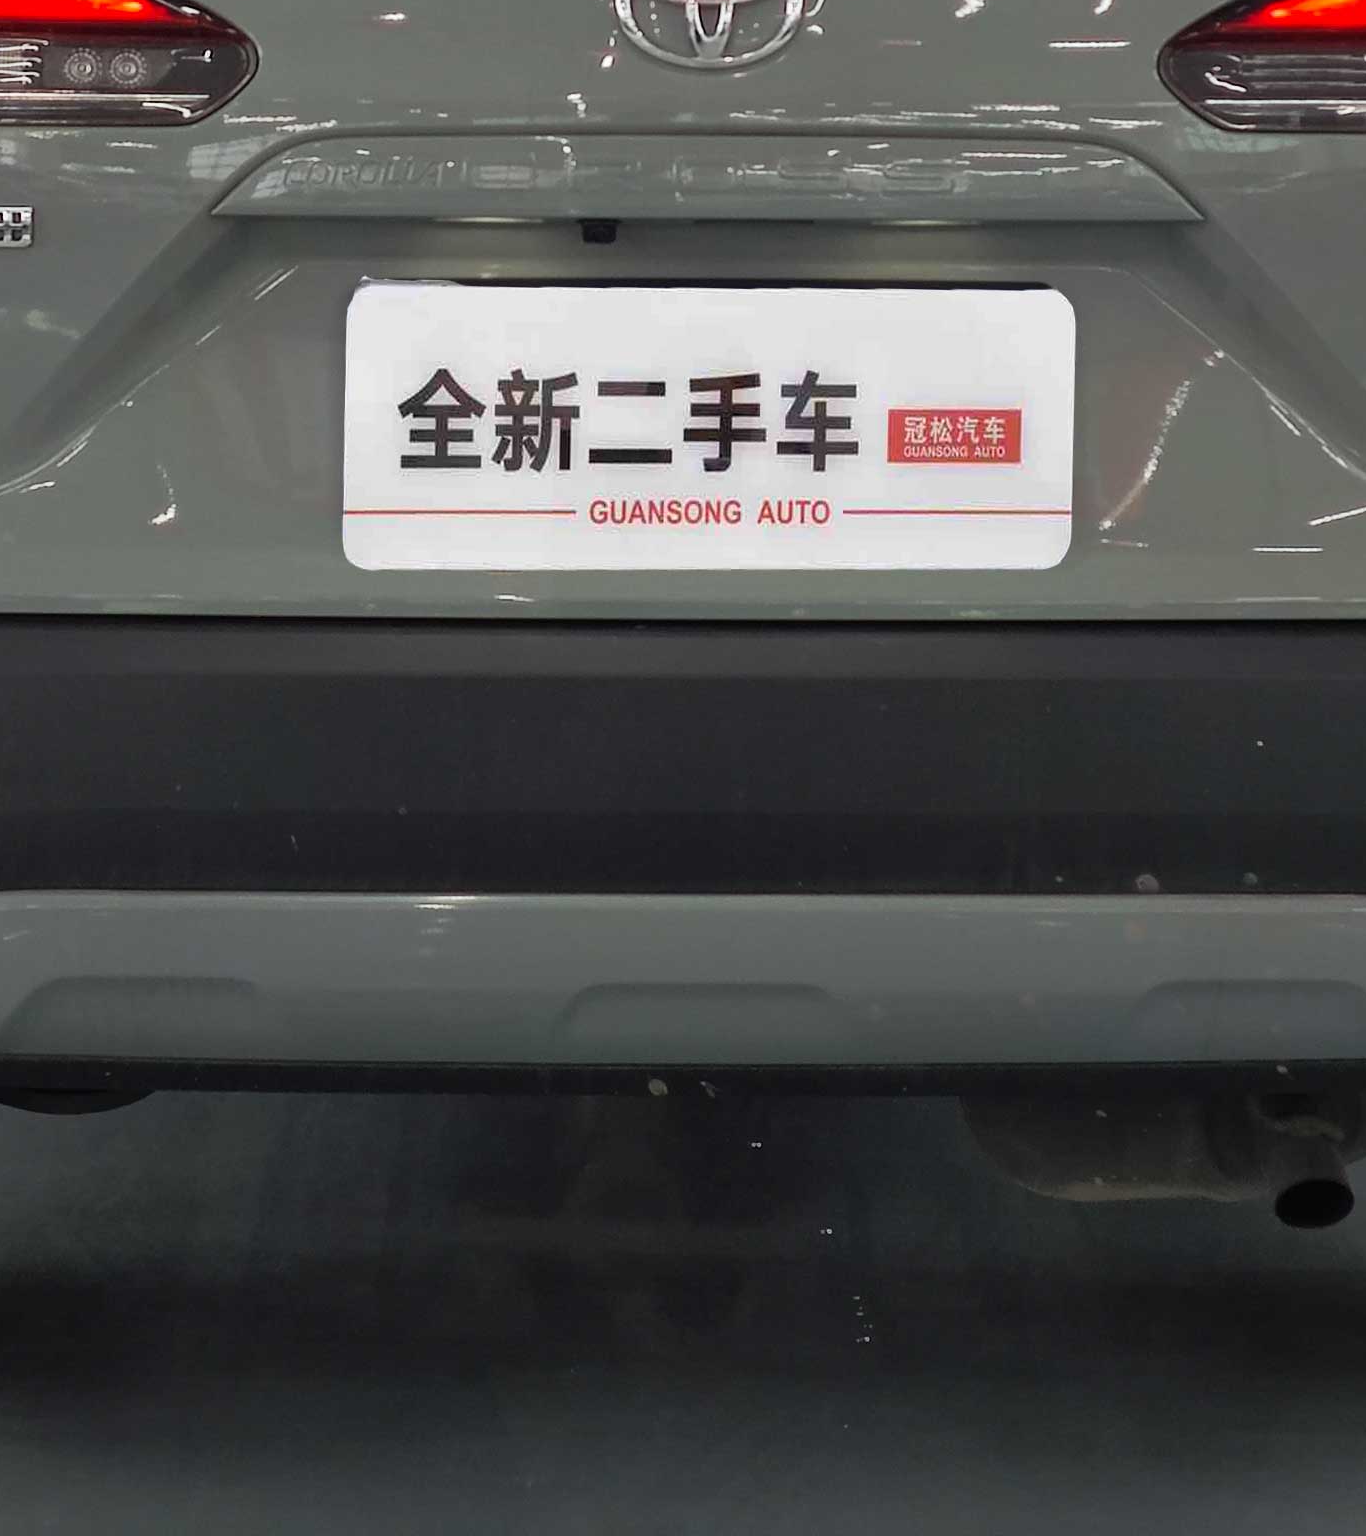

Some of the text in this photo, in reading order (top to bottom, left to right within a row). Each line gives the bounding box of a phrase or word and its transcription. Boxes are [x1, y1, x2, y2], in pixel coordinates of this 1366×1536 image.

[397, 368, 859, 473] 全新二手车
[904, 416, 1006, 444] 冠松汽车
[903, 445, 1006, 458] GUANSONG AUTO
[589, 498, 833, 525] GUANSONG AUTO
